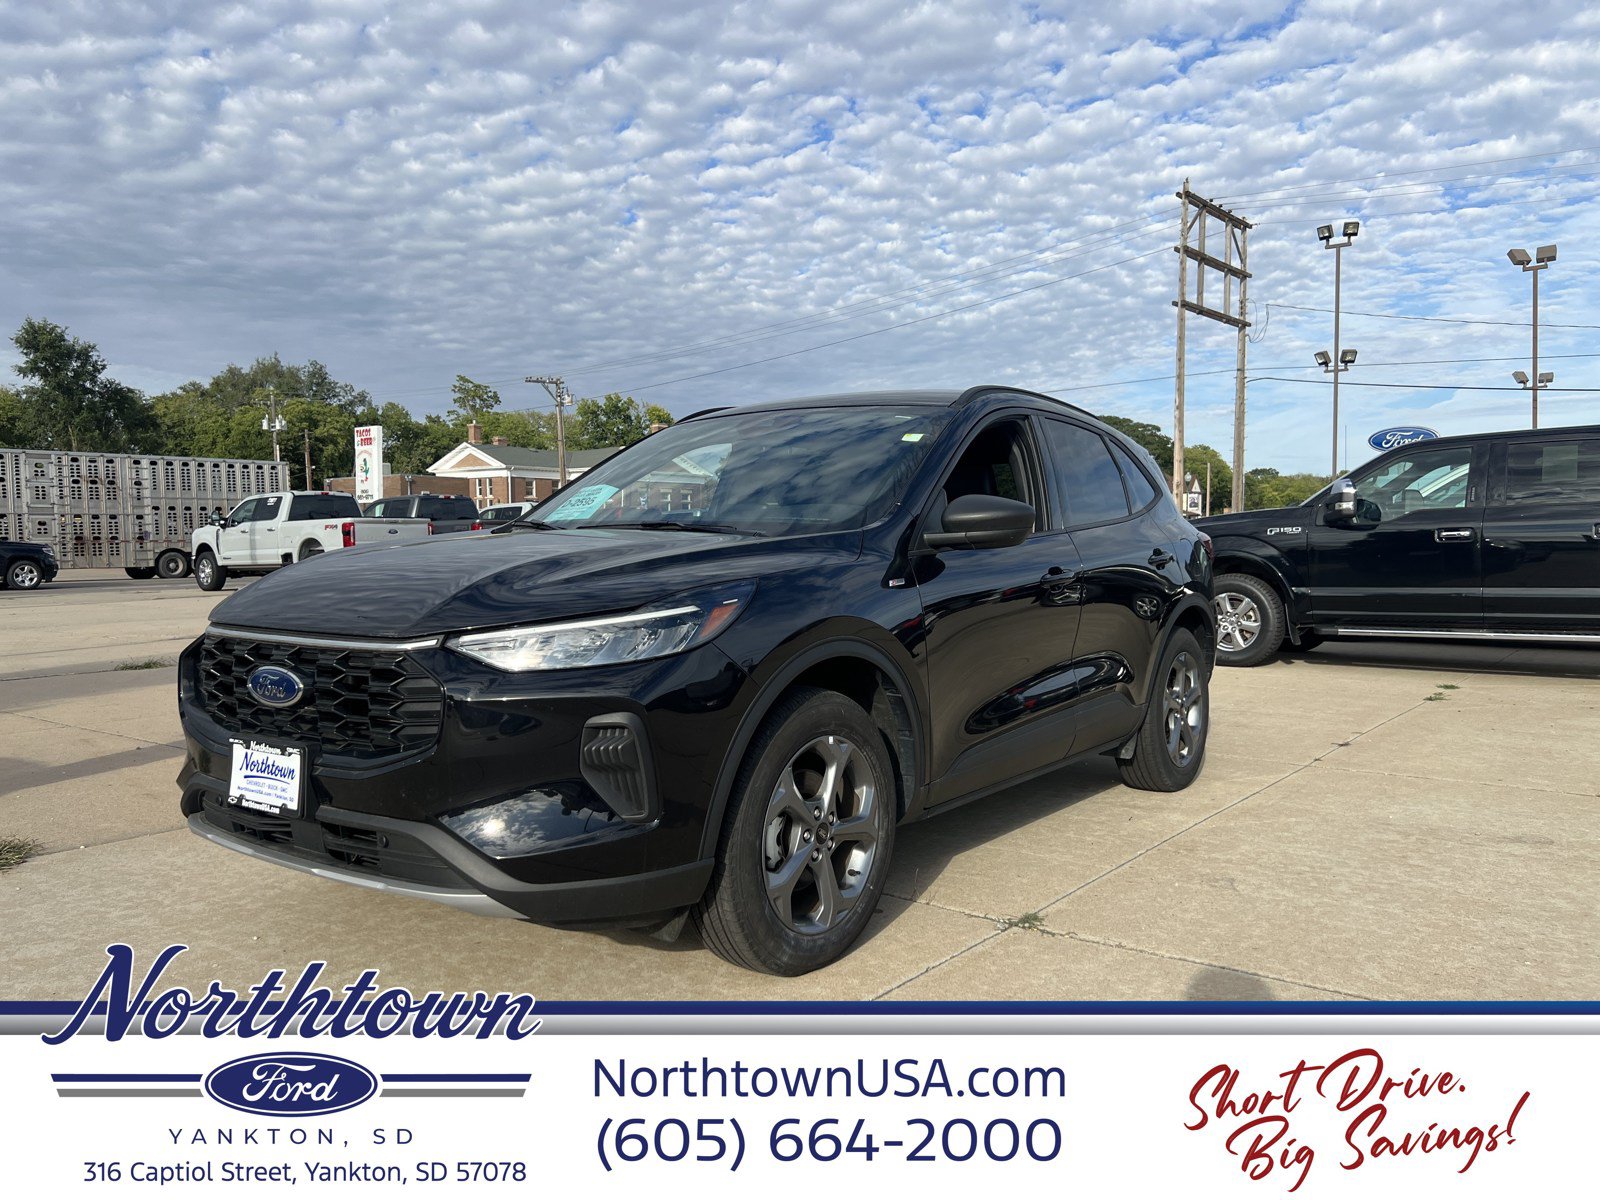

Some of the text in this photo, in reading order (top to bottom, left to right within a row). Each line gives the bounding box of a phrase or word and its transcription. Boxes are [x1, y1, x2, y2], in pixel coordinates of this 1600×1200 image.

[356, 428, 371, 437] TACOS
[360, 437, 373, 447] BEER
[256, 673, 287, 698] Ford
[250, 741, 282, 755] Northtown
[240, 751, 296, 780] Northtown
